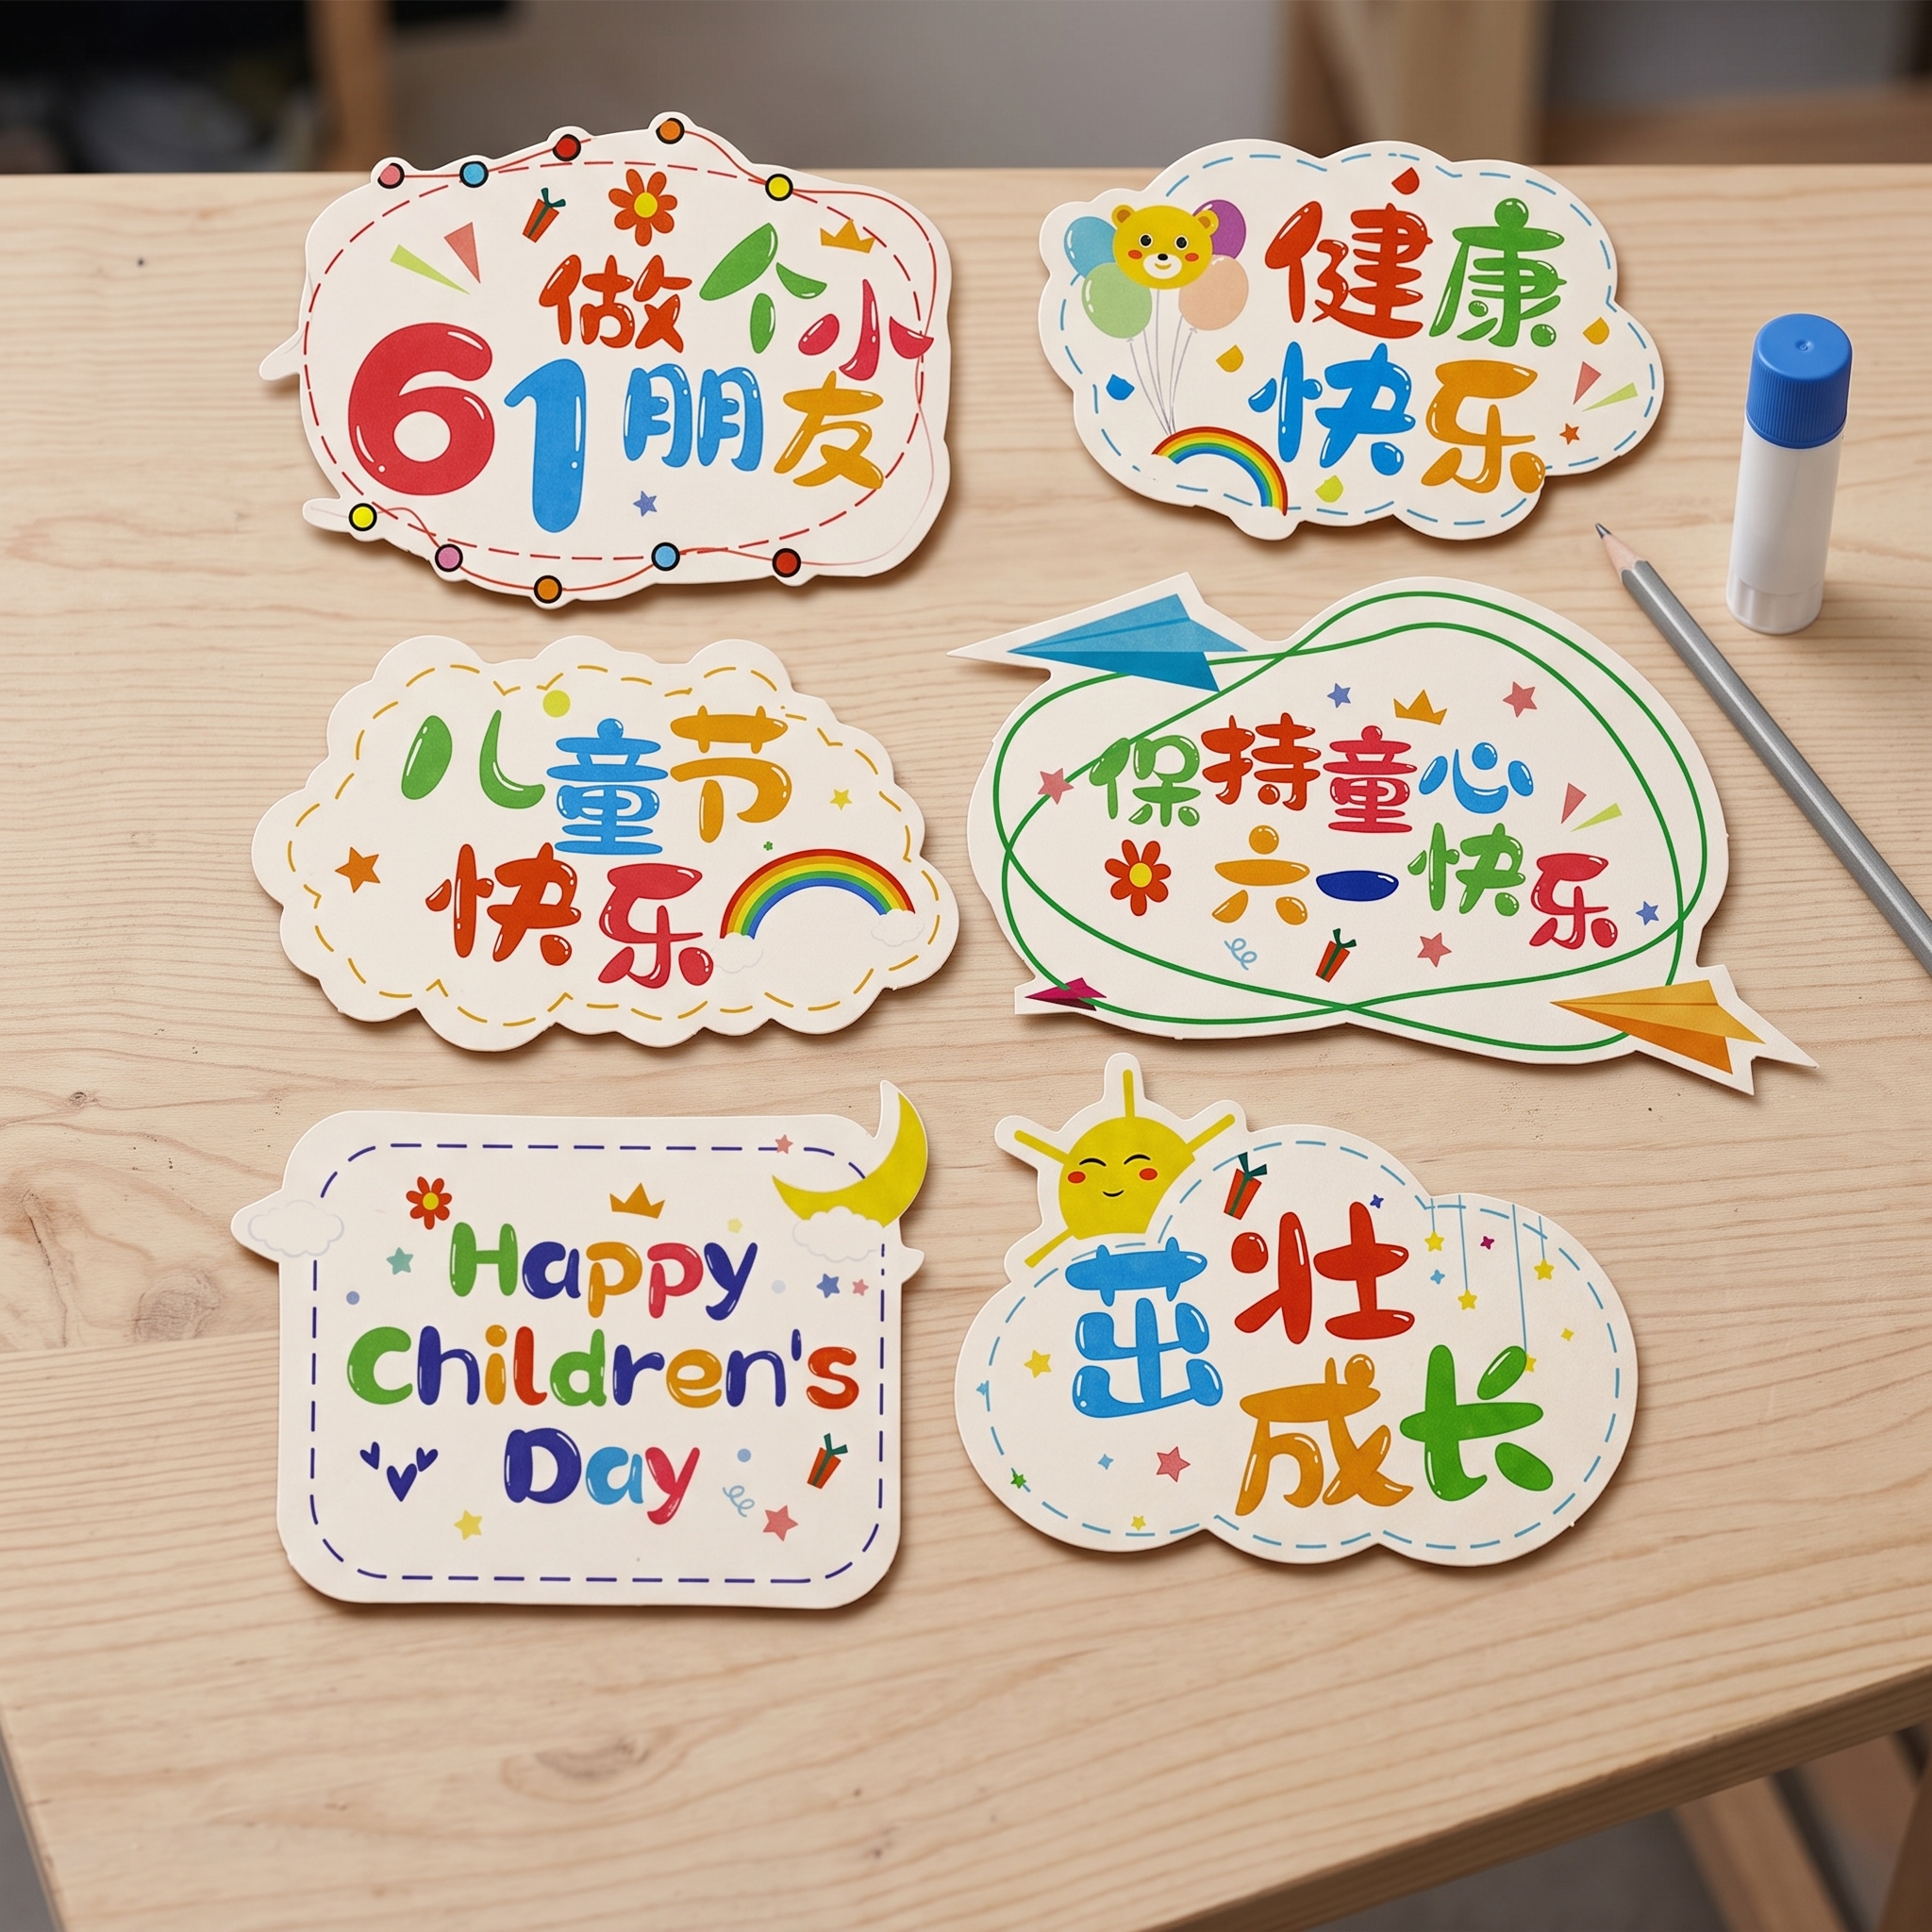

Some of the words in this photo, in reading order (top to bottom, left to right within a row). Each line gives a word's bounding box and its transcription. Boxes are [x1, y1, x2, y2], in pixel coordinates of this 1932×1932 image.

[539, 223, 935, 381] 做个小
[1265, 198, 1568, 348] 健康
[1248, 341, 1546, 494] 快乐
[401, 706, 792, 856] 儿童节
[1089, 712, 1535, 834] 保持童心
[425, 842, 714, 989] 快乐
[448, 1222, 758, 1321] Happy
[1065, 1201, 1415, 1418] 茁壮
[346, 1324, 859, 1410] Children's
[1235, 1344, 1554, 1516] 成长
[504, 1427, 700, 1525] Day
